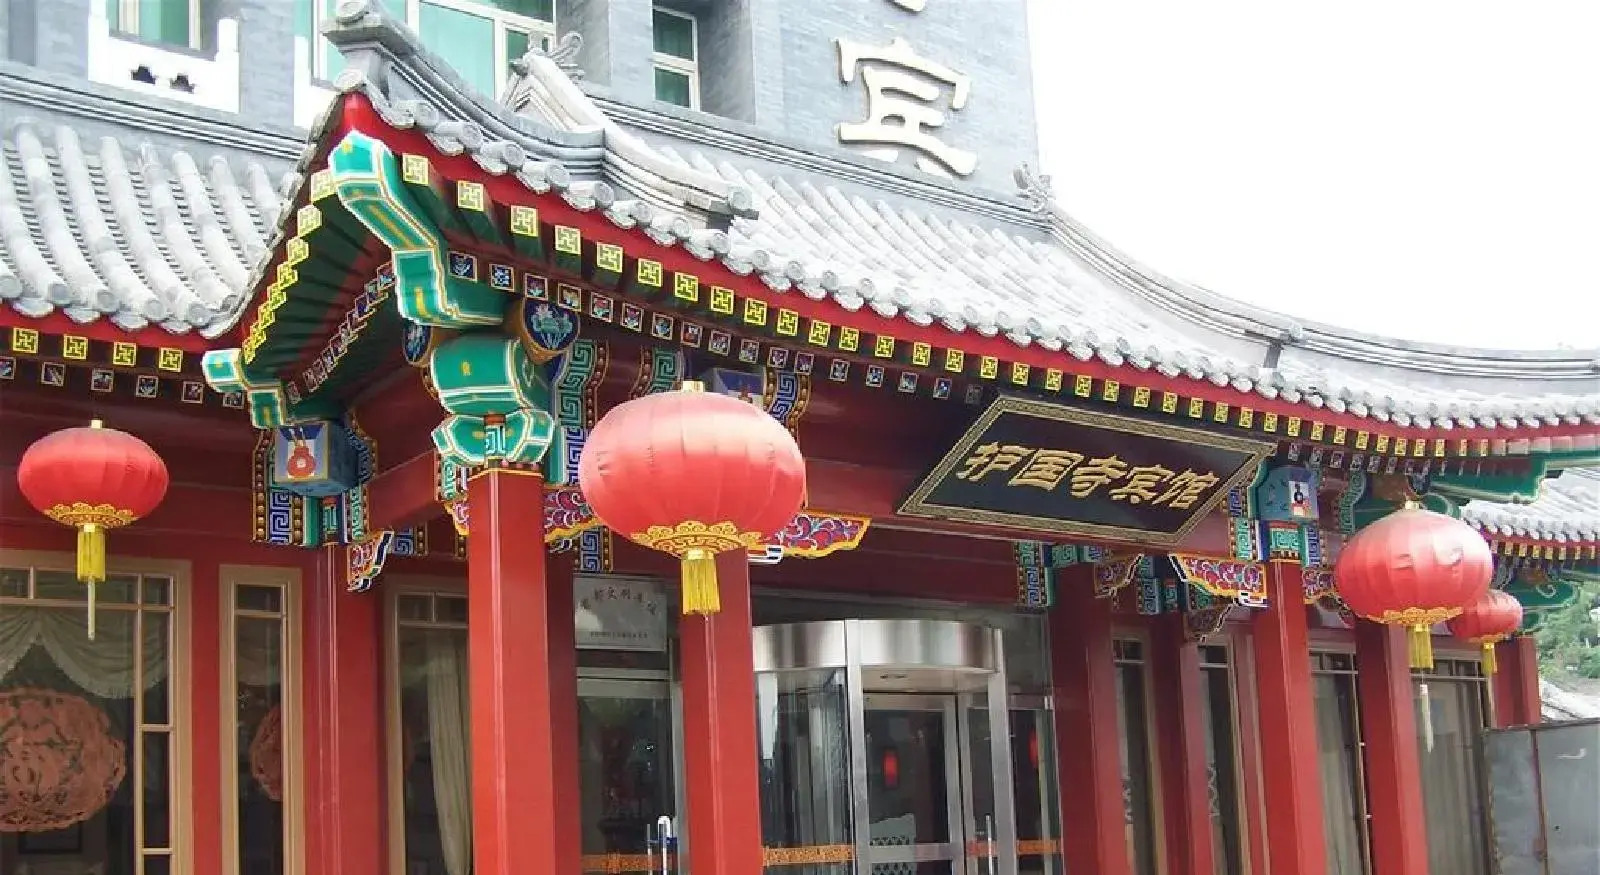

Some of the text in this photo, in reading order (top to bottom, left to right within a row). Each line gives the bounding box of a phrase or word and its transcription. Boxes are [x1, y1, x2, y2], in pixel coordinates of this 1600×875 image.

[831, 0, 977, 176] 宾
[956, 441, 1220, 510] 护国寺宾馆
